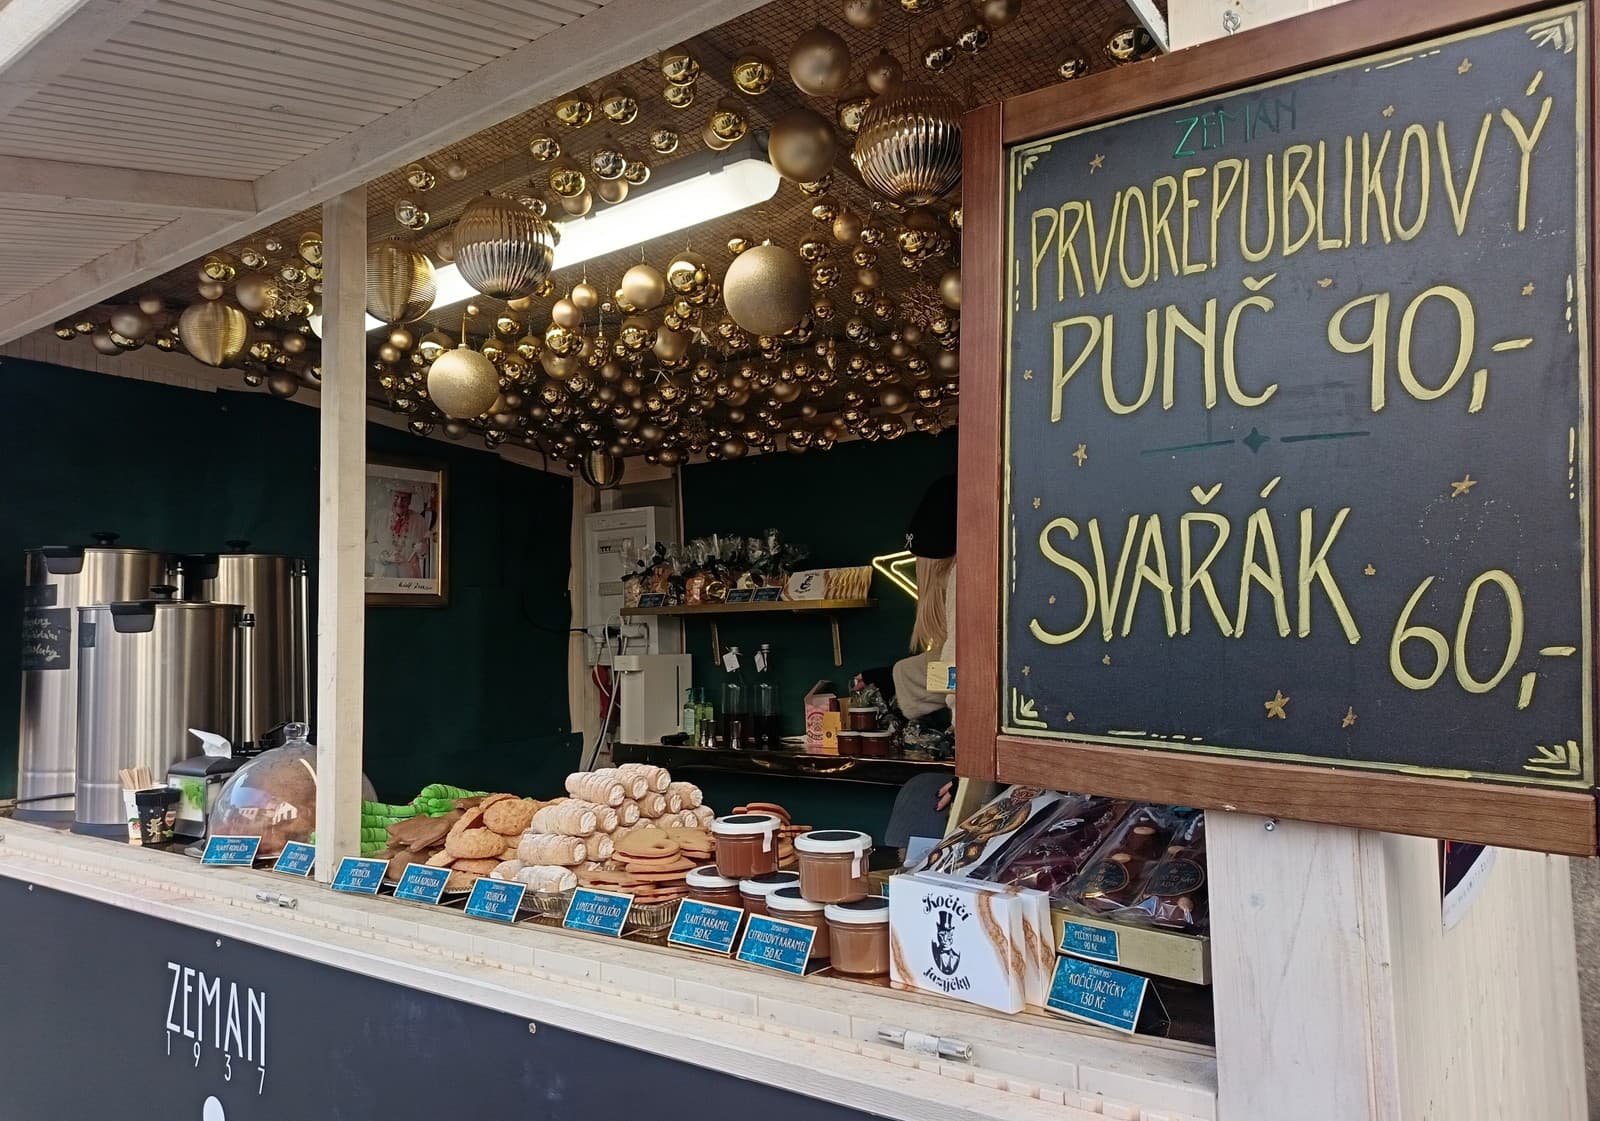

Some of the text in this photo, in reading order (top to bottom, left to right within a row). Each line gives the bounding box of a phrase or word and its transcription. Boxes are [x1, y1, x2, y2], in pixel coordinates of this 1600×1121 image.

[1173, 92, 1297, 158] ZEMAN
[1031, 70, 1553, 310] PRVOREPUBLIKOVÝ
[1051, 272, 1534, 423] PUNČ 90,-
[1029, 476, 1577, 710] SVAŘÁK 60,-
[598, 902, 621, 917] KOLEČKO
[683, 912, 729, 932] SLANÝ KARAMEL
[693, 927, 704, 938] 150
[703, 929, 711, 940] Kč
[748, 929, 781, 946] CITRUSOVÝ
[778, 937, 807, 953] KARAMEL
[1083, 942, 1091, 950] 90
[763, 948, 774, 958] 150
[773, 949, 783, 961] Kč
[1069, 971, 1126, 998] KOČIČÍ JAZÝČKY
[1080, 991, 1107, 1010] 130 Kč
[166, 961, 266, 1067] ZEMAN
